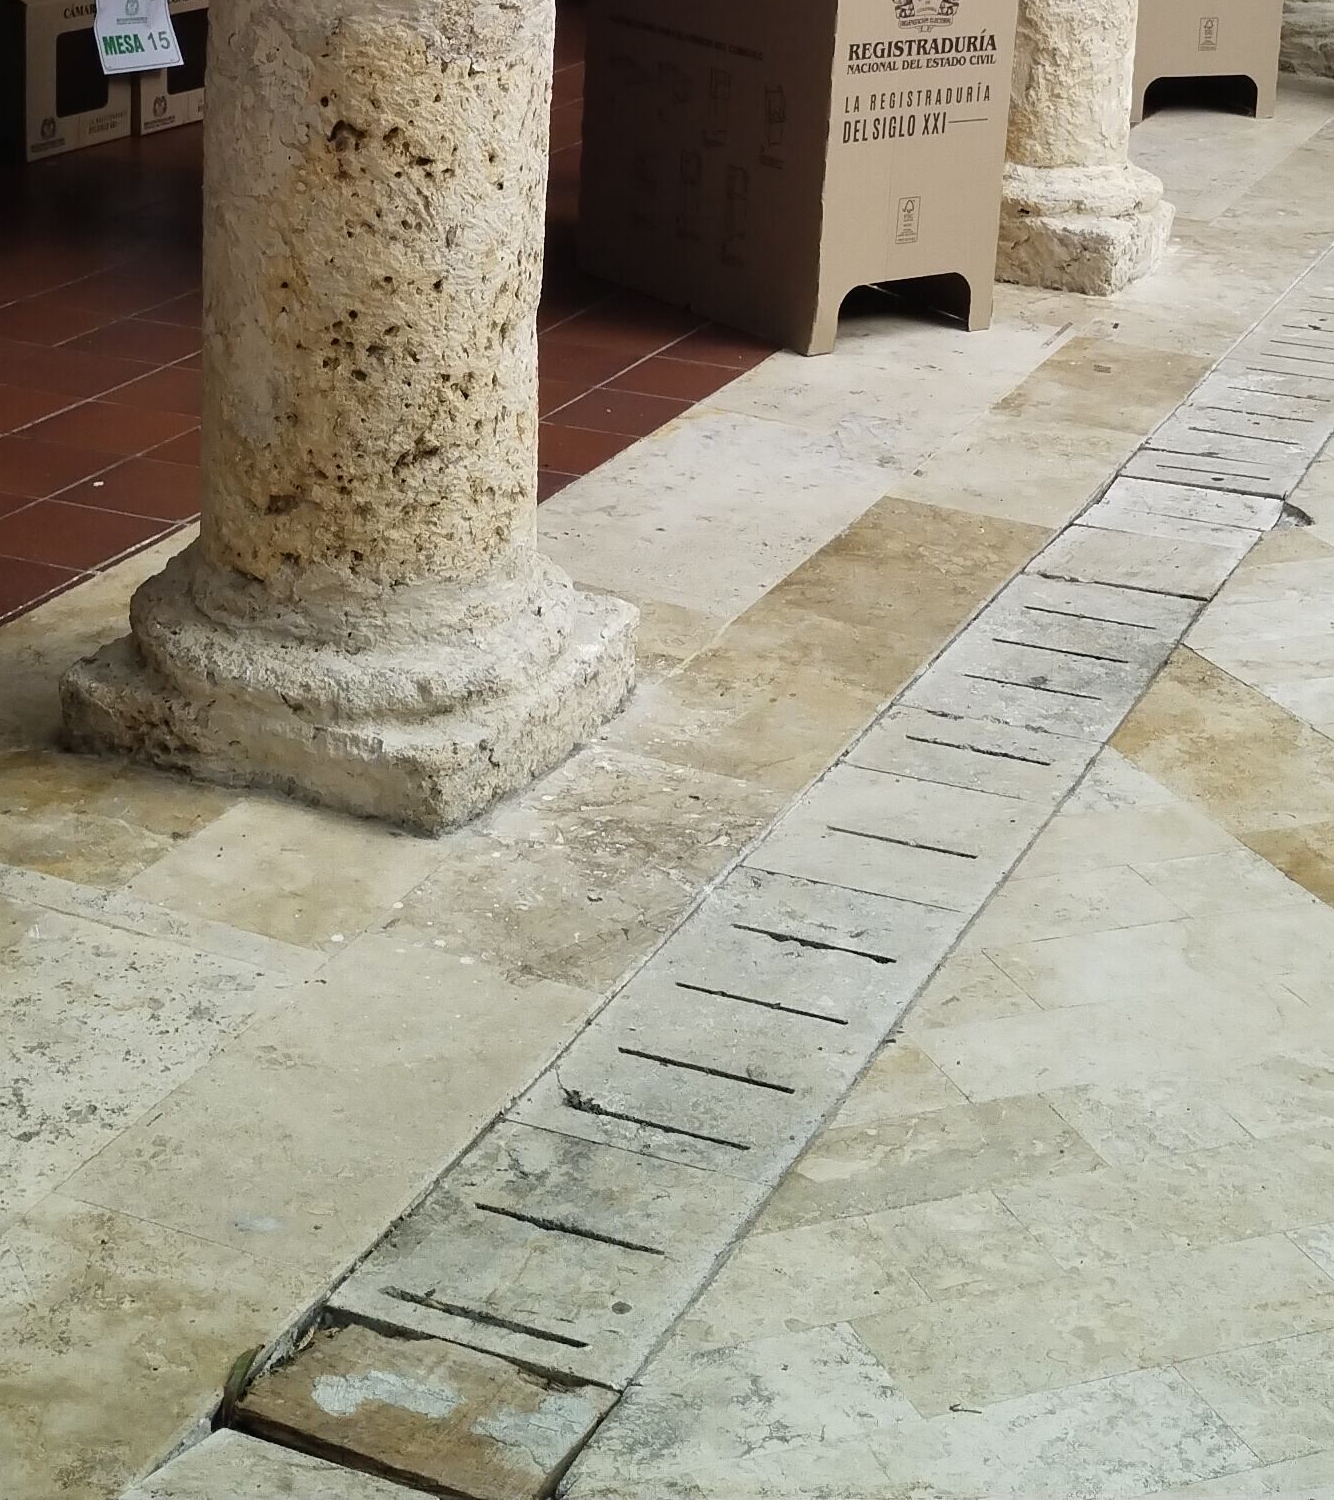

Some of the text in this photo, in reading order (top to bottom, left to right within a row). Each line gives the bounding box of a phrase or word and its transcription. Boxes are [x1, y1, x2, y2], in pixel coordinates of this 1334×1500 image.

[102, 31, 170, 56] MESA 15
[848, 28, 997, 61] REGISTRADURÍA
[847, 53, 996, 75] NACIONAL DEL ESTADO CIVIL
[845, 82, 991, 113] LA REGISTRADURÍA
[843, 112, 947, 143] DEL SIGLO XXI
